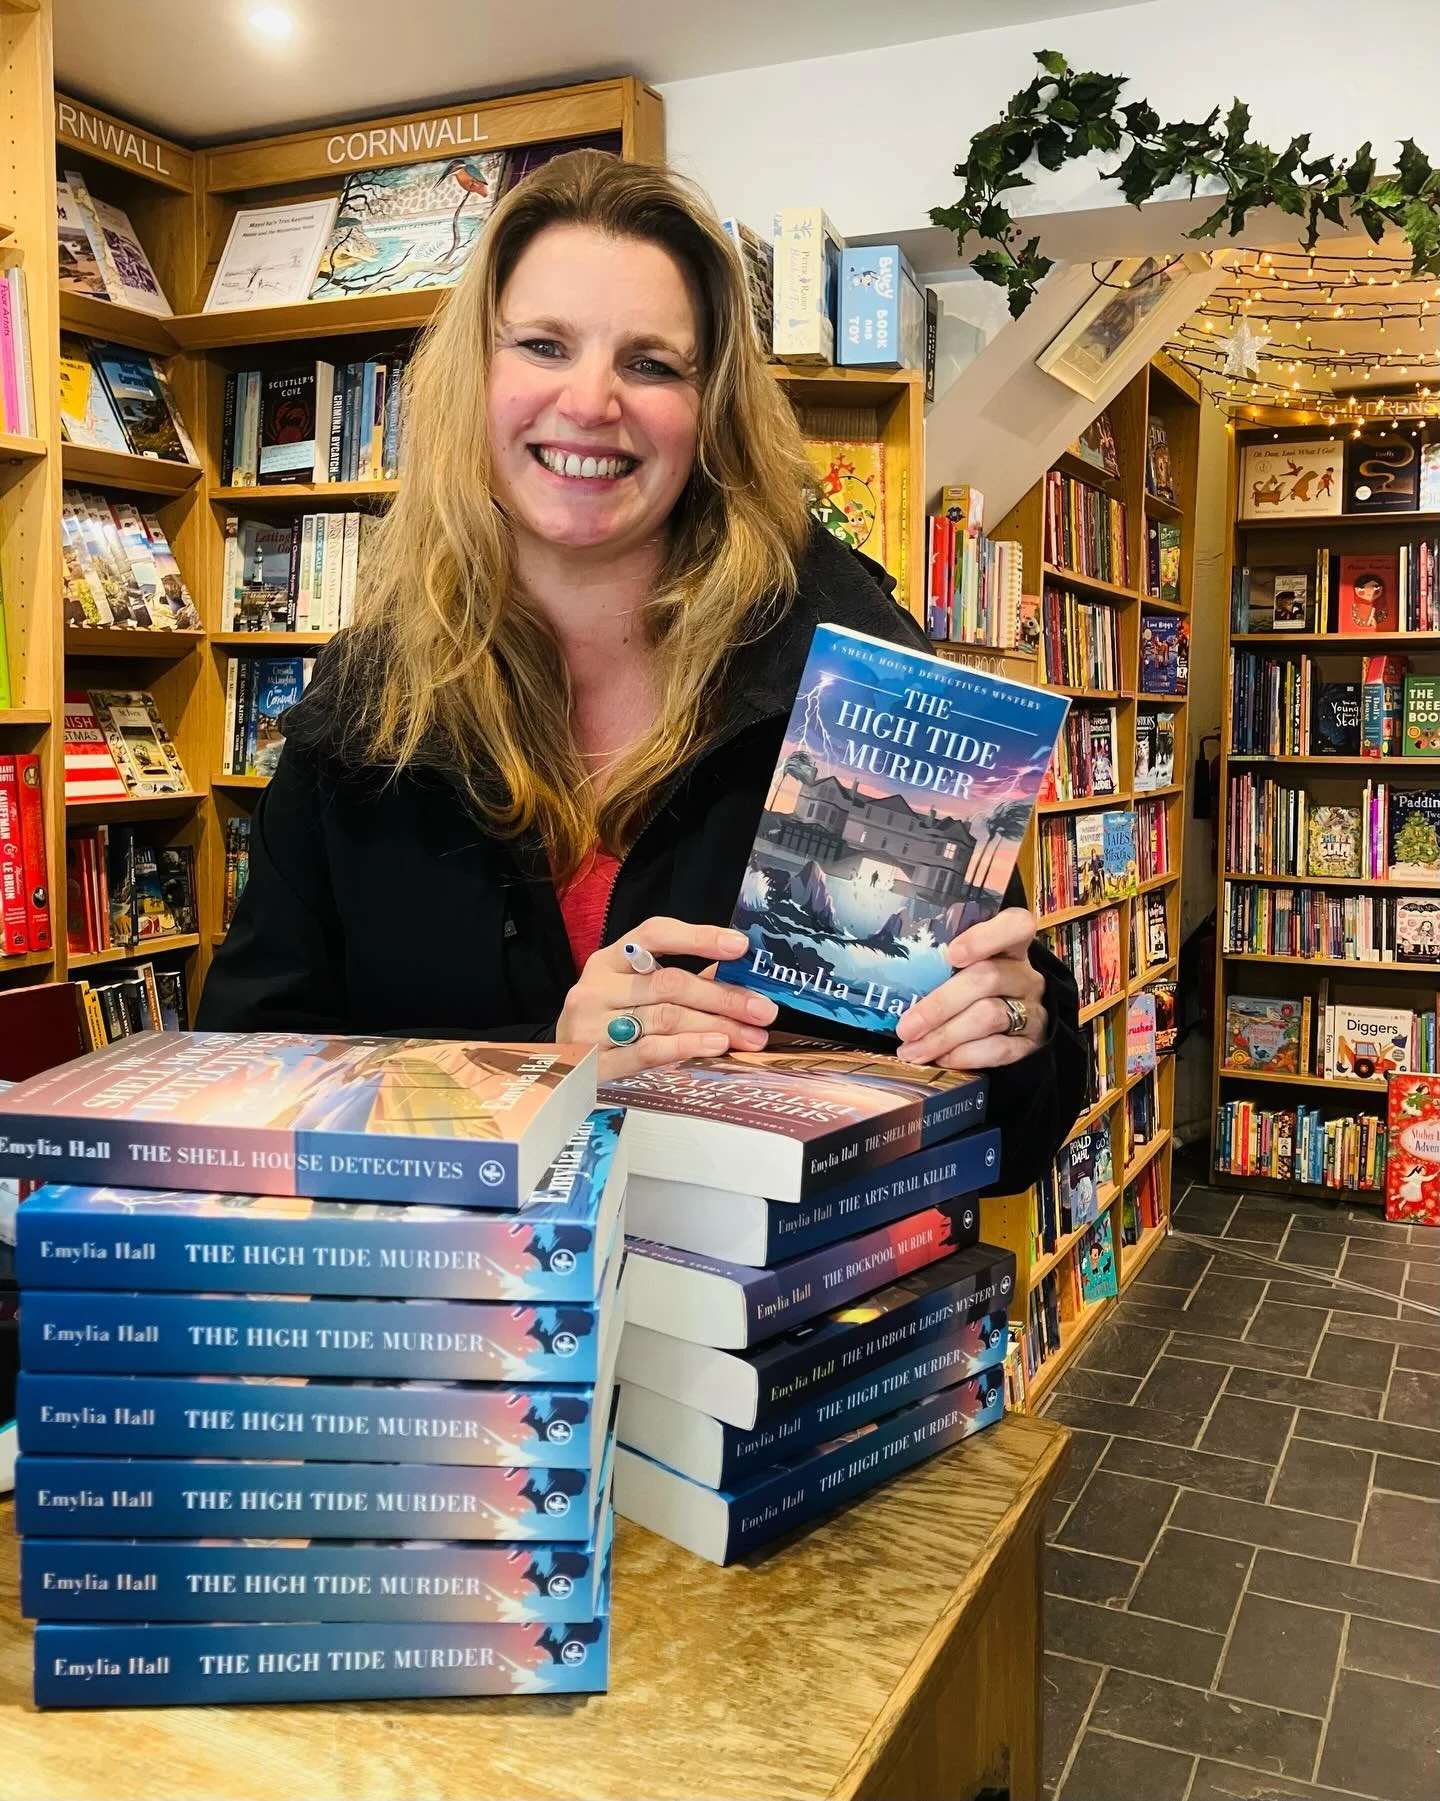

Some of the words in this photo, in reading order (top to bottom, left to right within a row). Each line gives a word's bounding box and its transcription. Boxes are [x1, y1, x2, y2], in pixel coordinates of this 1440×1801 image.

[327, 114, 489, 165] CORNWALL
[2, 308, 10, 336] Artists
[848, 316, 860, 345] TOY
[876, 308, 889, 349] BOOK
[268, 375, 315, 390] SCUTTLER'S
[281, 388, 302, 397] COVE
[332, 394, 343, 434] CRIMINAL
[329, 436, 341, 473] BYCATCH
[840, 647, 876, 664] SHELL
[879, 657, 915, 674] HOUSE
[918, 669, 988, 696] DETECTIVES
[992, 689, 1042, 711] MYSTERY
[266, 686, 298, 708] Cornwall
[902, 688, 953, 720] THE
[1409, 689, 1434, 699] THE
[1409, 701, 1440, 711] TREE
[1331, 701, 1360, 718] Young
[836, 700, 922, 748] HIGH
[926, 725, 1001, 770] TIDE
[839, 739, 975, 800] MURDER
[3, 861, 13, 873] LE
[4, 873, 16, 900] BRUN
[749, 949, 849, 1000] Emylia
[1347, 1019, 1398, 1036] Diggers
[1325, 1034, 1333, 1053] Farm
[104, 1054, 156, 1072] THE
[130, 1032, 293, 1111] DETECTIVES
[524, 1053, 562, 1076] Hall
[82, 1067, 184, 1111] SHELL
[731, 1096, 838, 1123] SHELL
[810, 1152, 839, 1175] Emylia
[841, 1143, 858, 1161] Hall
[864, 1133, 881, 1153] THE
[882, 1126, 905, 1146] SHELL
[907, 1115, 932, 1135] HOUSE
[933, 1097, 974, 1125] DETECTIVES
[1069, 1135, 1092, 1154] ROALD
[1415, 1140, 1439, 1153] Adven
[0, 1135, 62, 1159] Emylia
[69, 1139, 110, 1159] Hall
[128, 1143, 172, 1163] THE
[177, 1147, 245, 1168] SHELL
[251, 1151, 323, 1172] HOUSE
[331, 1155, 463, 1180] DETECTIVES
[1071, 1149, 1090, 1166] DAHL
[530, 1148, 584, 1203] Emylia
[778, 1212, 810, 1235] Emylia
[813, 1203, 833, 1227] Hall
[838, 1194, 861, 1216] THE
[863, 1184, 889, 1208] ARTS
[891, 1175, 920, 1198] TRAIL
[923, 1163, 957, 1187] KILLER
[40, 1241, 107, 1263] Emylia
[115, 1242, 156, 1260] Hall
[185, 1244, 235, 1264] THE
[243, 1245, 305, 1266] HIGH
[312, 1247, 371, 1268] TIDE
[380, 1249, 482, 1270] MURDER
[757, 1295, 789, 1320] Emylia
[792, 1282, 811, 1303] Hall
[823, 1268, 844, 1290] THE
[846, 1246, 896, 1279] ROCKPOOL
[898, 1228, 933, 1254] MURDER
[43, 1323, 110, 1346] Emylia
[118, 1325, 159, 1343] Hall
[188, 1326, 239, 1346] THE
[247, 1328, 308, 1348] HIGH
[316, 1330, 374, 1350] TIDE
[383, 1332, 485, 1352] MURDER
[771, 1376, 808, 1402] Emylia
[812, 1359, 835, 1383] Hall
[840, 1346, 863, 1369] THE
[866, 1320, 917, 1356] HARBOUR
[918, 1303, 953, 1331] LIGHTS
[954, 1283, 999, 1313] MYSTERY
[736, 1433, 775, 1457] Emylia
[778, 1416, 802, 1441] Hall
[816, 1398, 843, 1423] THE
[847, 1383, 878, 1411] HIGH
[882, 1371, 910, 1396] TIDE
[913, 1348, 961, 1379] MURDER
[40, 1406, 107, 1428] Emylia
[114, 1407, 155, 1426] Hall
[184, 1409, 235, 1430] THE
[242, 1411, 304, 1432] HIGH
[311, 1413, 370, 1435] TIDE
[377, 1416, 479, 1438] MURDER
[741, 1507, 778, 1533] Emylia
[782, 1487, 805, 1512] Hall
[819, 1467, 845, 1493] THE
[848, 1450, 879, 1478] HIGH
[882, 1435, 910, 1460] TIDE
[913, 1410, 959, 1443] MURDER
[37, 1489, 104, 1512] Emylia
[112, 1491, 153, 1508] Hall
[182, 1491, 233, 1510] THE
[240, 1491, 302, 1511] HIGH
[310, 1492, 368, 1512] TIDE
[375, 1494, 478, 1513] MURDER
[43, 1573, 109, 1594] Emylia
[117, 1574, 158, 1591] Hall
[187, 1574, 237, 1594] THE
[244, 1575, 307, 1594] HIGH
[313, 1576, 371, 1595] TIDE
[380, 1576, 482, 1596] MURDER
[54, 1658, 121, 1681] Emylia
[128, 1657, 171, 1675] Hall
[200, 1655, 250, 1675] THE
[257, 1652, 320, 1674] HIGH
[328, 1651, 386, 1671] TIDE
[394, 1648, 495, 1669] MURDER
